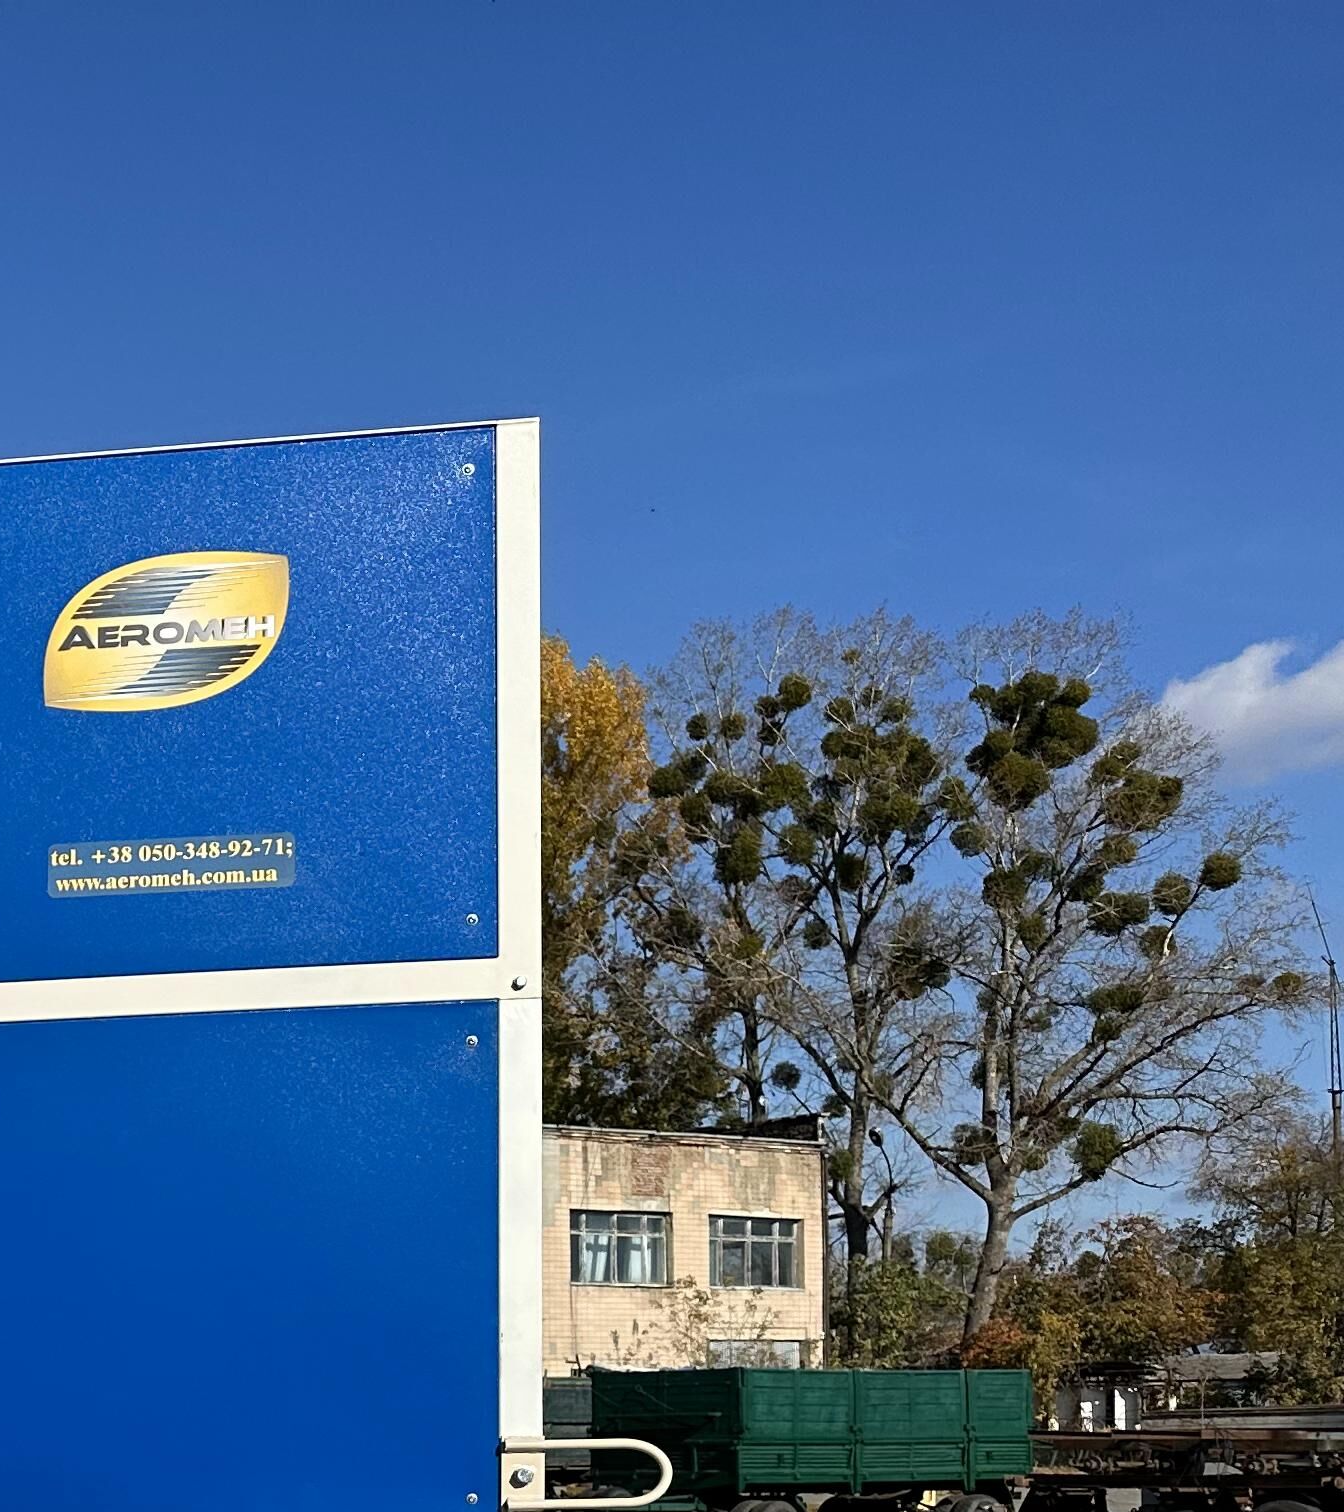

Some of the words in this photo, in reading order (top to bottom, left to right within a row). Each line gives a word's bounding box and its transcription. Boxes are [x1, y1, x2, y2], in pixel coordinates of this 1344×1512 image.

[58, 615, 275, 651] AEROMEH
[50, 848, 83, 867] tel.
[91, 846, 132, 864] +38
[138, 838, 294, 863] 050-348-92-71;
[55, 868, 278, 892] www.aeromeh.com.ua
